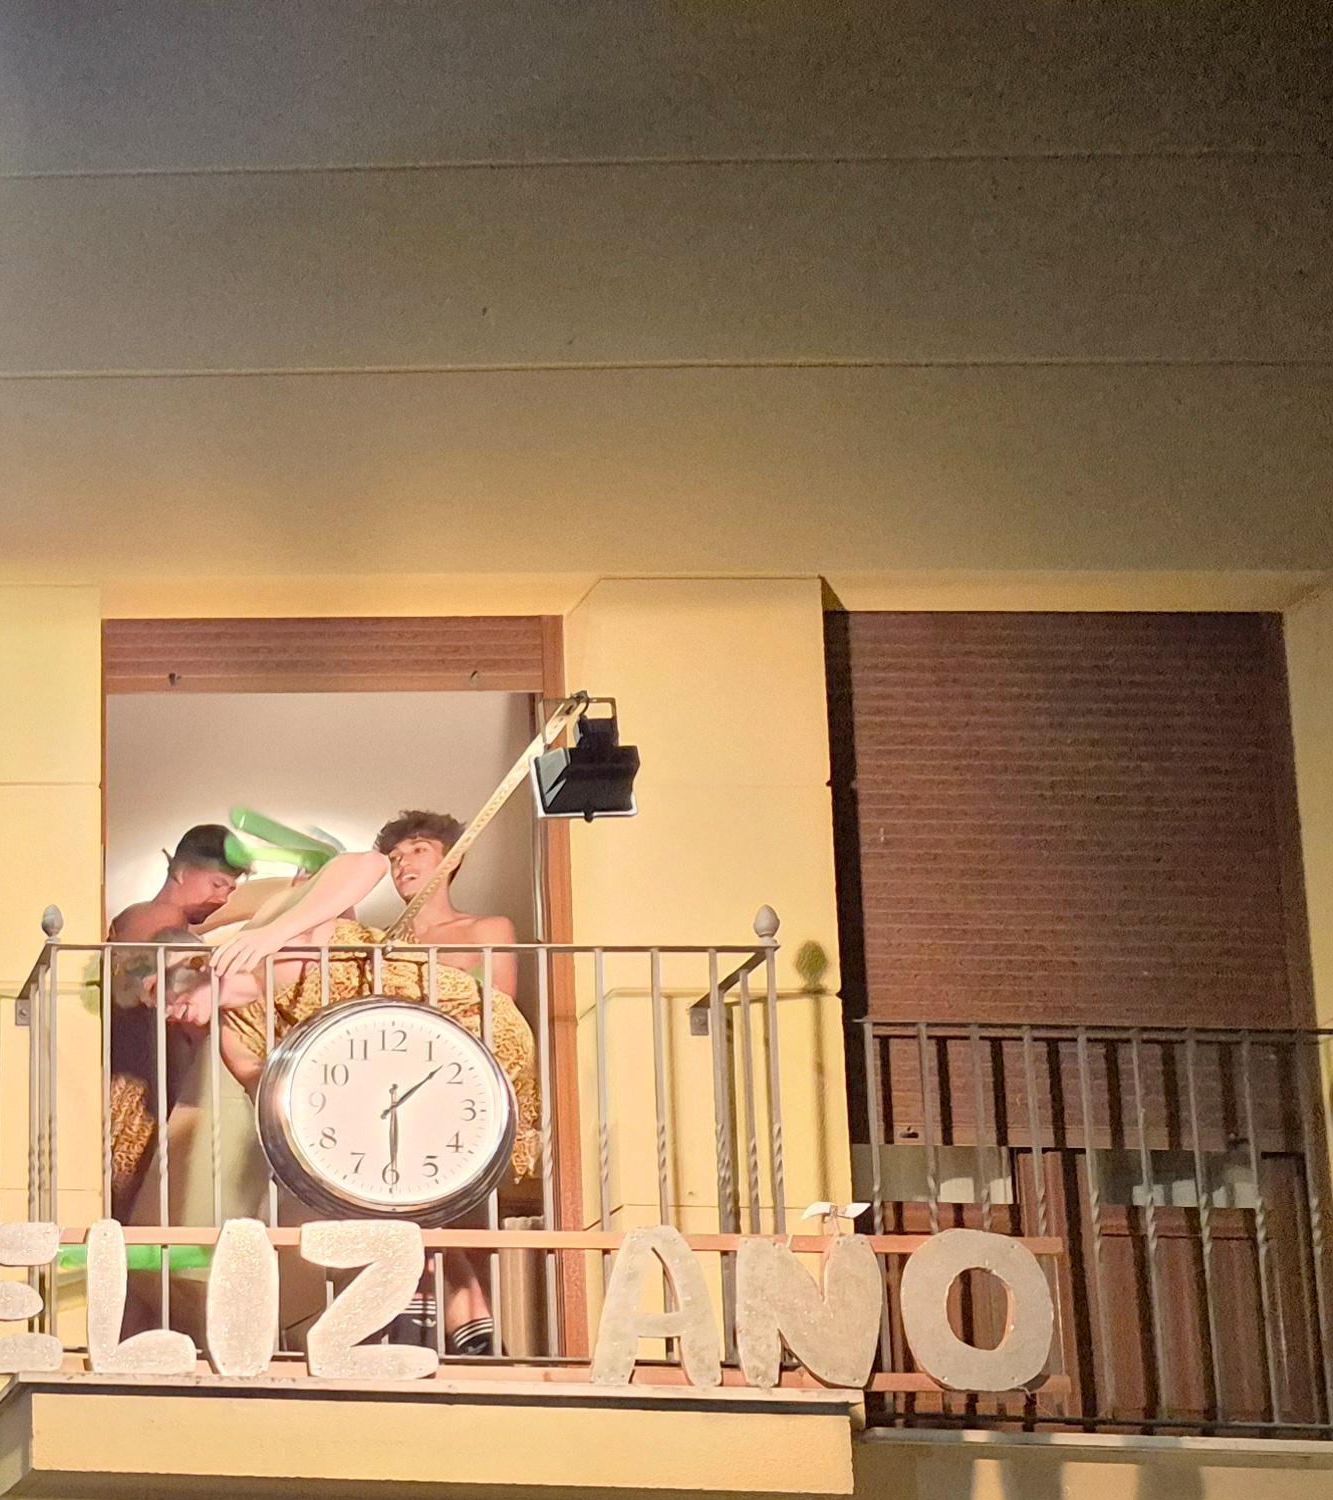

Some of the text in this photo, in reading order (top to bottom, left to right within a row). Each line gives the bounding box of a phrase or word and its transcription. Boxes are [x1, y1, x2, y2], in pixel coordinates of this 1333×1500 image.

[348, 1039, 370, 1061] 11
[379, 1030, 408, 1052] 12
[424, 1040, 434, 1061] 1
[322, 1064, 350, 1086] 10
[446, 1062, 464, 1085] 2
[308, 1092, 327, 1115] 9
[460, 1099, 477, 1121] 3
[319, 1127, 337, 1149] 8
[445, 1131, 464, 1153] 4
[350, 1152, 366, 1174] 7
[382, 1162, 400, 1185] 6
[422, 1155, 439, 1177] 5
[590, 1201, 1055, 1392] AÑO
